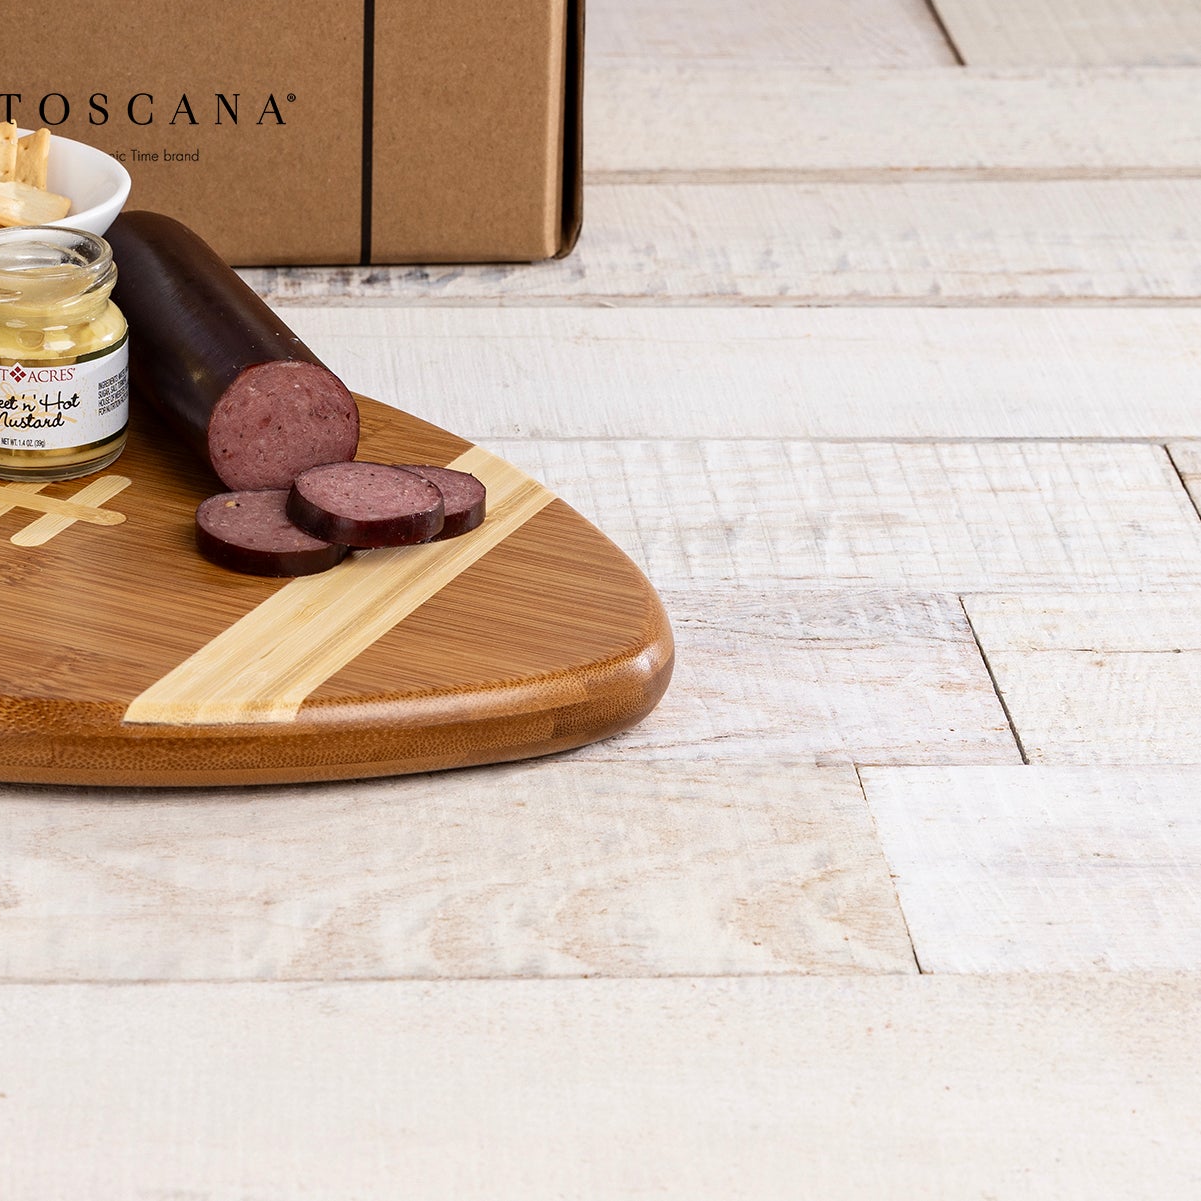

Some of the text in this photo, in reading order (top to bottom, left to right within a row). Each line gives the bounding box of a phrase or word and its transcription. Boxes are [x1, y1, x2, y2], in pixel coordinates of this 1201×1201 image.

[131, 149, 159, 162] Time
[163, 148, 200, 162] brand
[28, 367, 75, 383] ACRES
[39, 391, 80, 412] Hot
